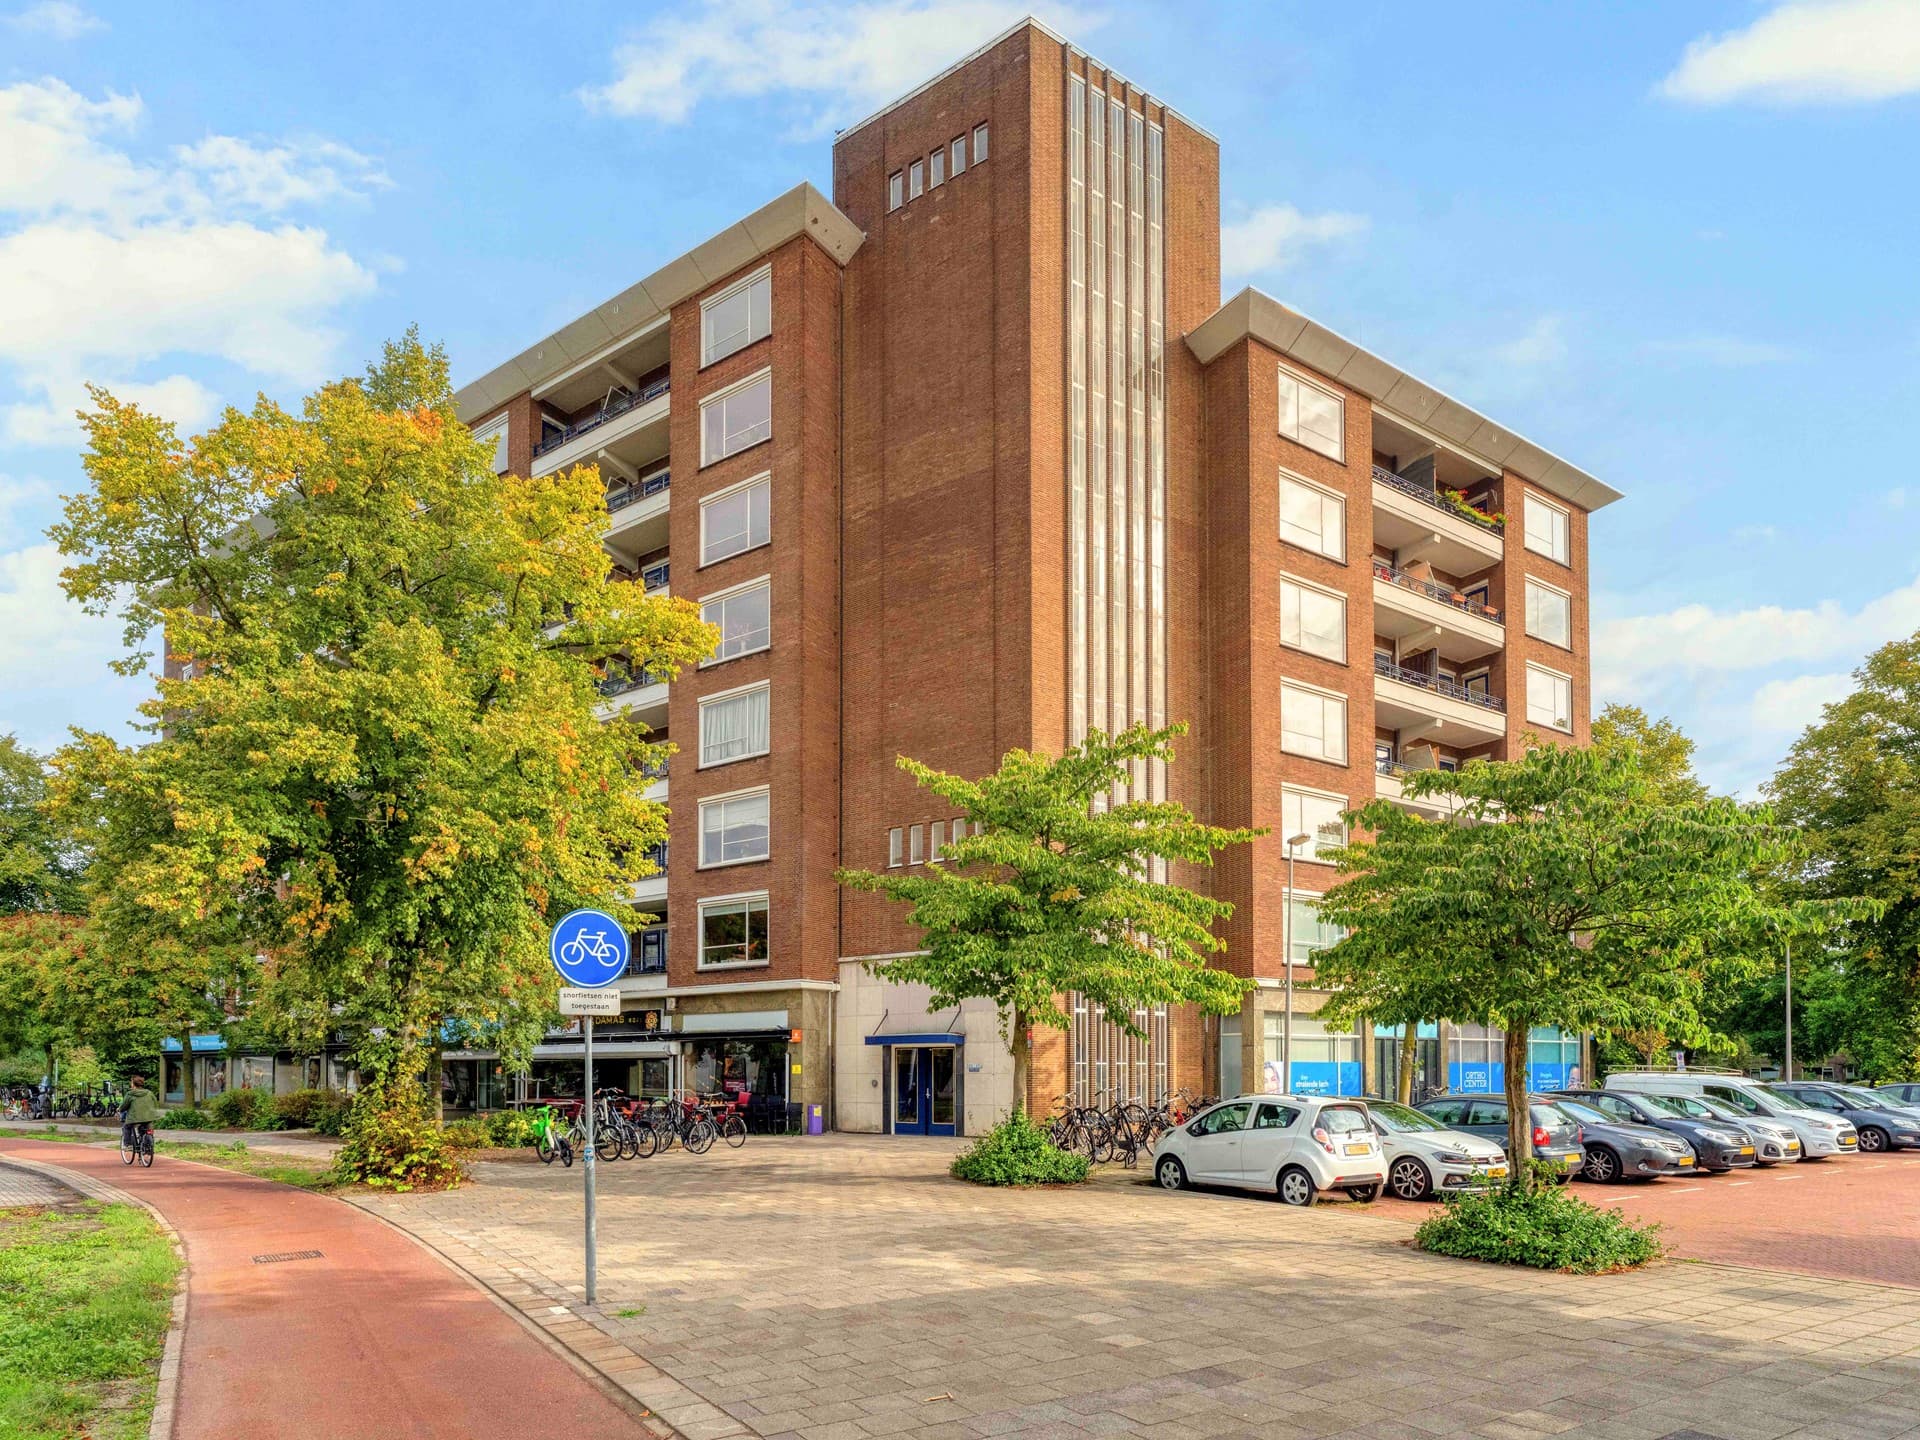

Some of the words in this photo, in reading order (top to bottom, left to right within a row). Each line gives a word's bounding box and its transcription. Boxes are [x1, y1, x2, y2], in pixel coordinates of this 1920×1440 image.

[604, 992, 618, 1000] niet
[595, 1015, 625, 1025] DAMAS
[1465, 1071, 1486, 1080] ORTHO
[1464, 1080, 1487, 1088] CENTER
